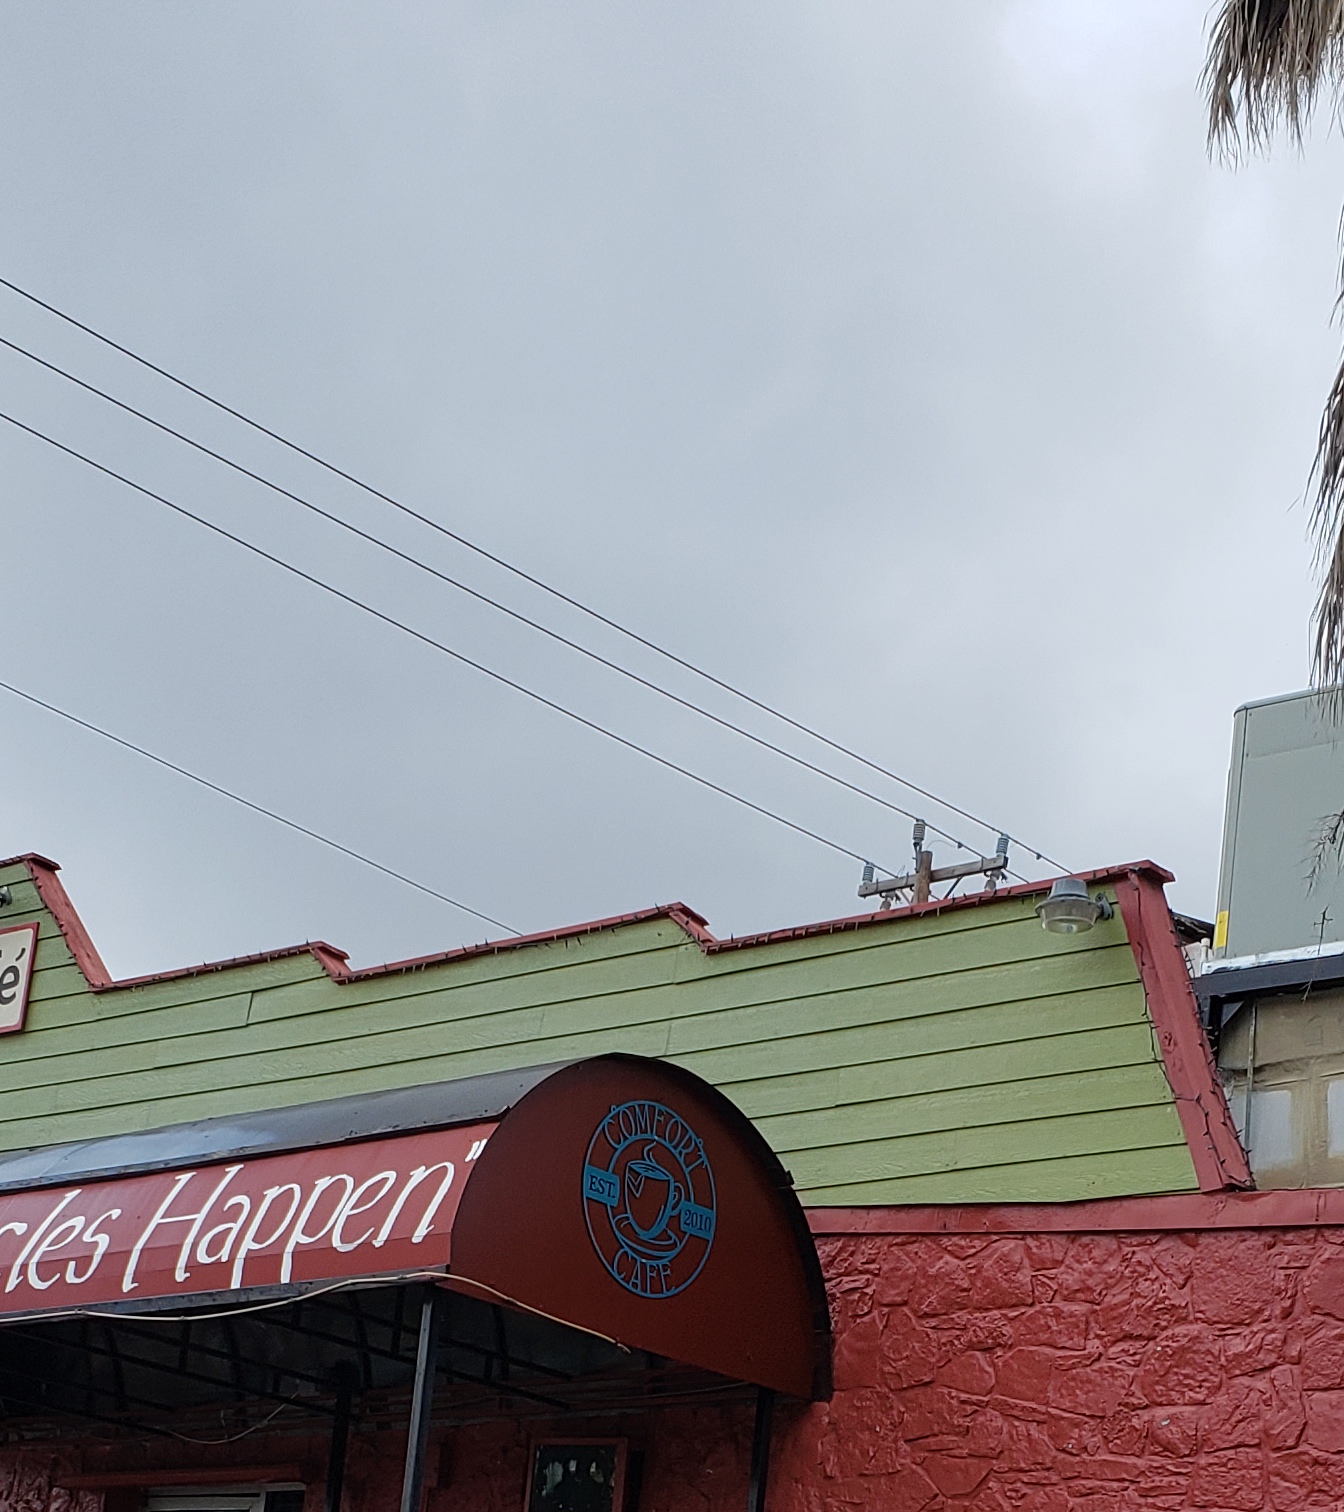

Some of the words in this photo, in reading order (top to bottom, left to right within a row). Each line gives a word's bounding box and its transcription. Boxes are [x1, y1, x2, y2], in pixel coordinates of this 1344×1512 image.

[602, 1103, 706, 1173] COMFORT
[588, 1174, 616, 1199] EST.
[683, 1209, 712, 1233] 2010
[613, 1247, 677, 1295] CAFE
